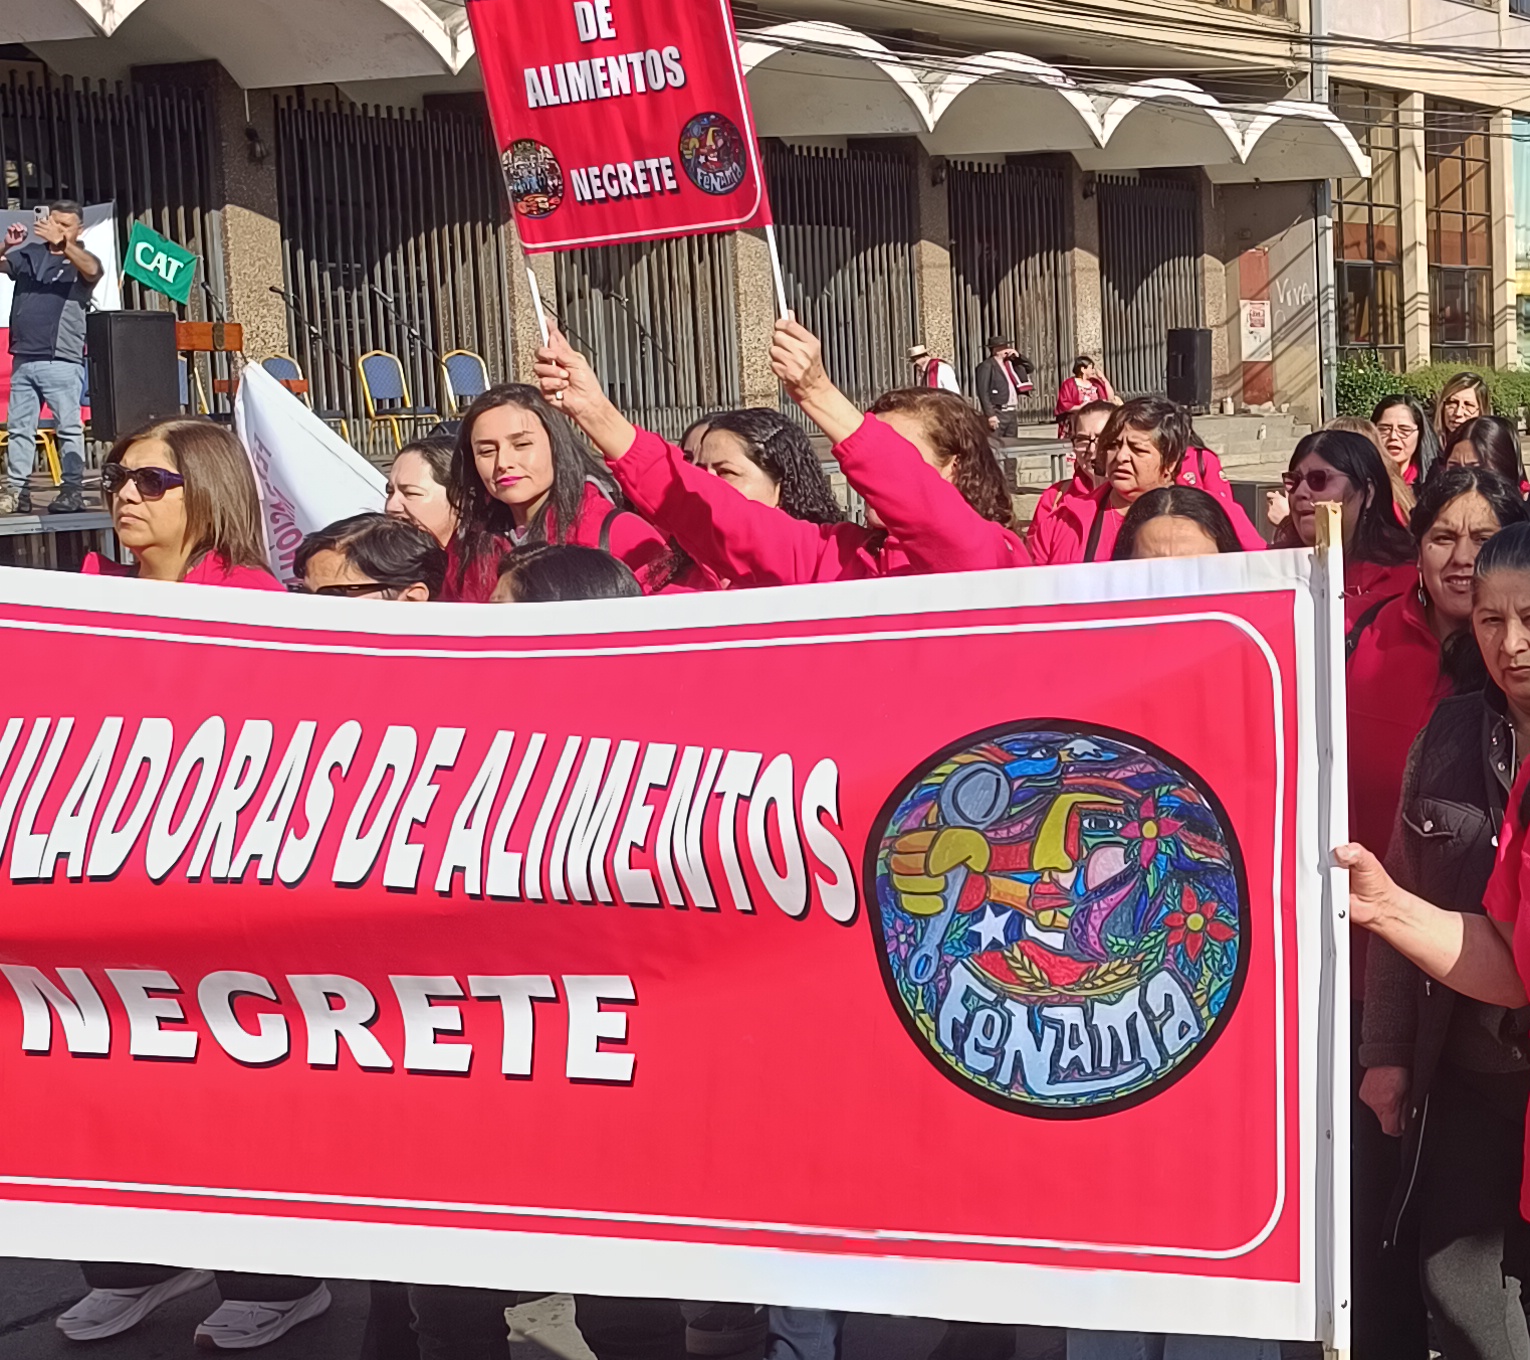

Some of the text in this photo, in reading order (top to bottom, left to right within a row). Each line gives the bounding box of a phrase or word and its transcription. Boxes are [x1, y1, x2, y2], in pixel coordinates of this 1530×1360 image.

[524, 46, 685, 108] ALIMENTOS
[570, 156, 677, 202] NEGRETE
[135, 241, 184, 283] CAT
[332, 725, 466, 888] DE
[434, 729, 857, 922] ALIMENTOS
[0, 963, 636, 1081] NEGRETE
